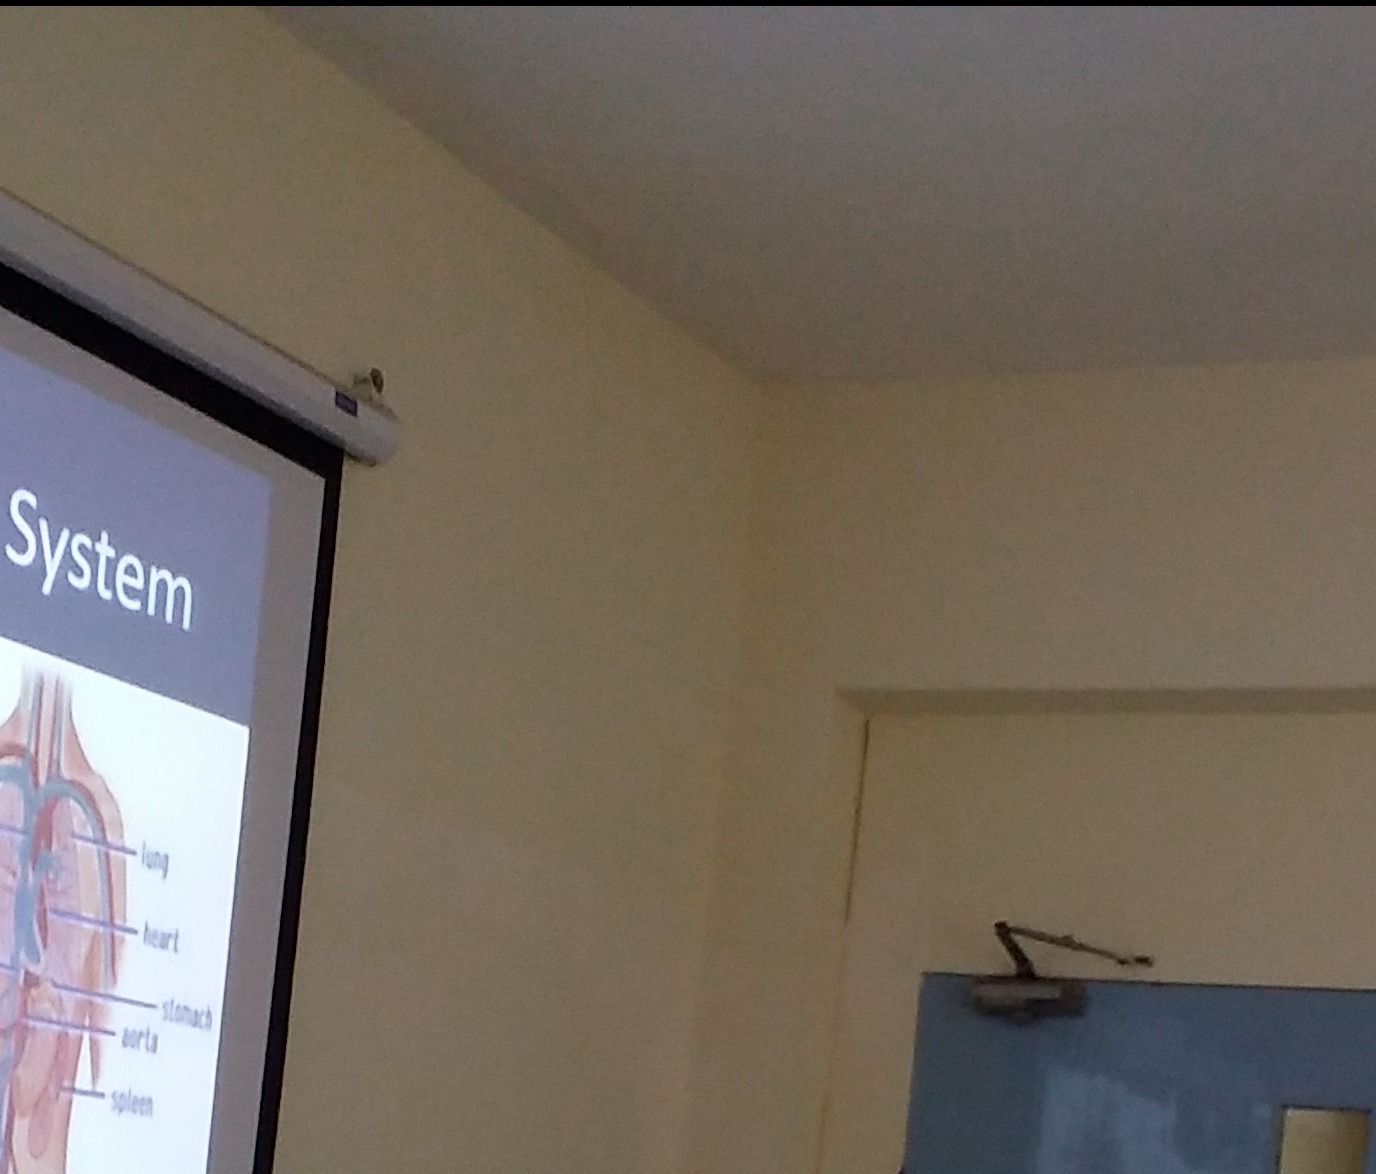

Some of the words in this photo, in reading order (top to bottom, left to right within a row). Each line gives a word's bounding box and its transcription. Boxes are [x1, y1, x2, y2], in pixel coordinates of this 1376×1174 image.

[4, 488, 195, 630] System
[140, 841, 170, 879] lung
[143, 921, 180, 953] heart
[161, 998, 214, 1030] stomach
[120, 1026, 158, 1054] aorta
[110, 1089, 154, 1117] spleen
